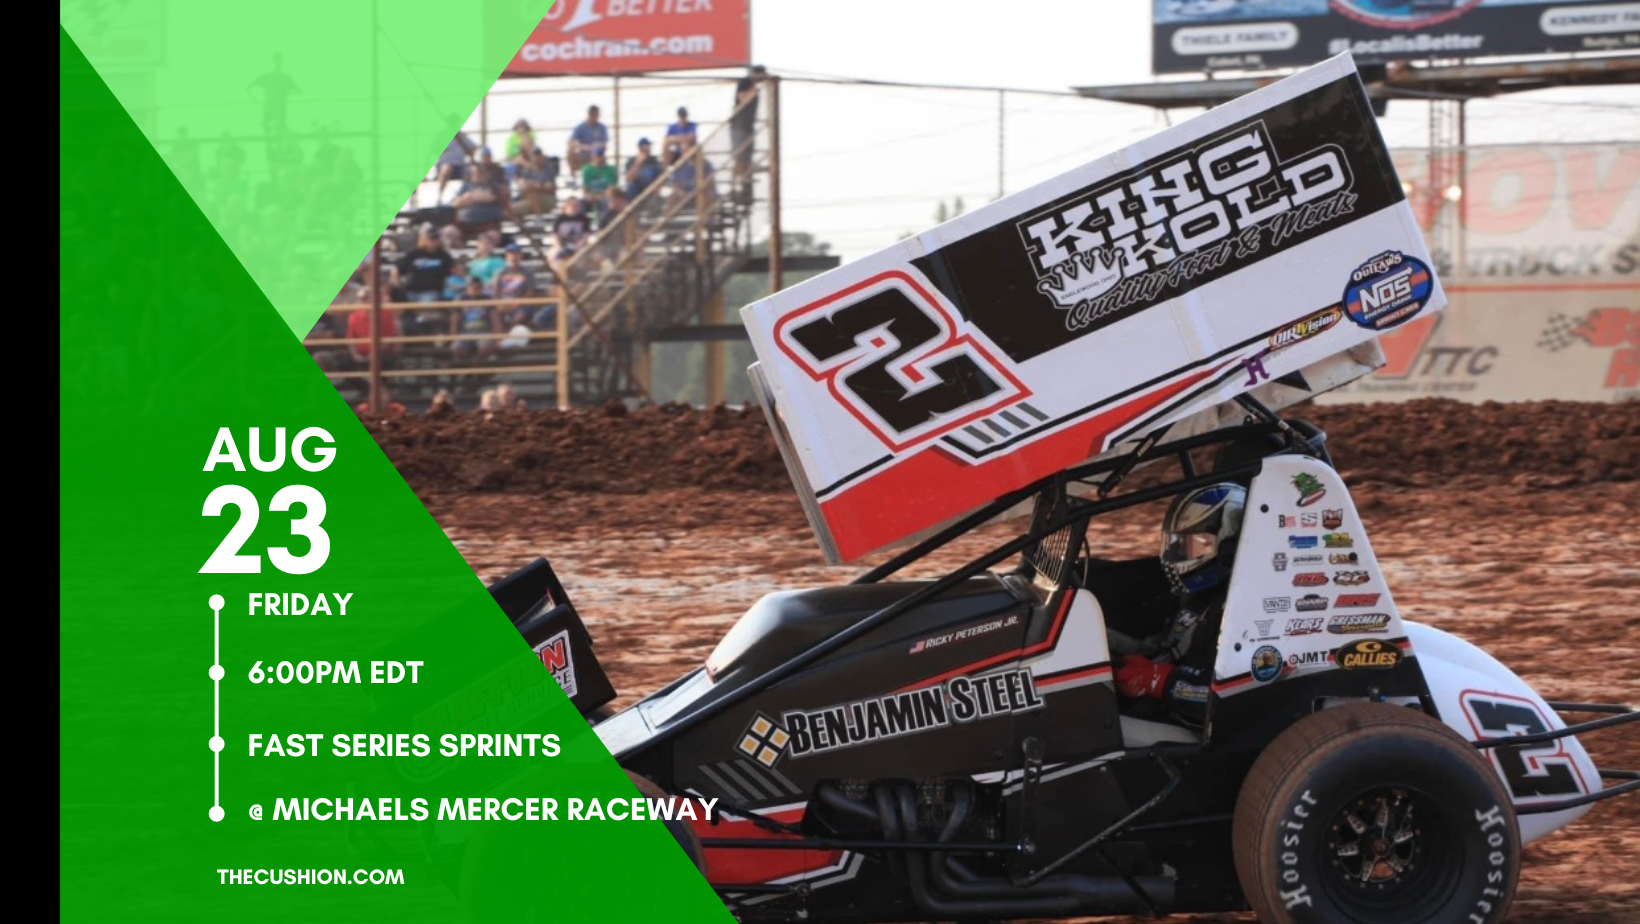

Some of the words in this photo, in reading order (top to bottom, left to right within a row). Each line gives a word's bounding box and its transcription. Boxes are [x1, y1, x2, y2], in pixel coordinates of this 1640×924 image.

[521, 34, 713, 61] cochran.com
[1027, 130, 1271, 268] KING
[1122, 151, 1346, 277] KOLD
[1067, 272, 1167, 330] Quality
[1168, 245, 1231, 287] Food
[1236, 229, 1261, 258] &
[1270, 191, 1357, 246] Meats
[1353, 254, 1402, 281] OUTLAWS
[1360, 269, 1412, 313] NOS
[783, 278, 1016, 442] 2
[925, 633, 954, 649] RICKY
[955, 619, 1003, 641] PETERSON
[1297, 651, 1328, 664] JMT
[1344, 652, 1397, 667] CALLIES
[784, 685, 947, 757] BENJAMIN
[947, 670, 1044, 722] STEEL
[1279, 789, 1317, 910] Hoosier
[1470, 804, 1505, 924] Hoosier
